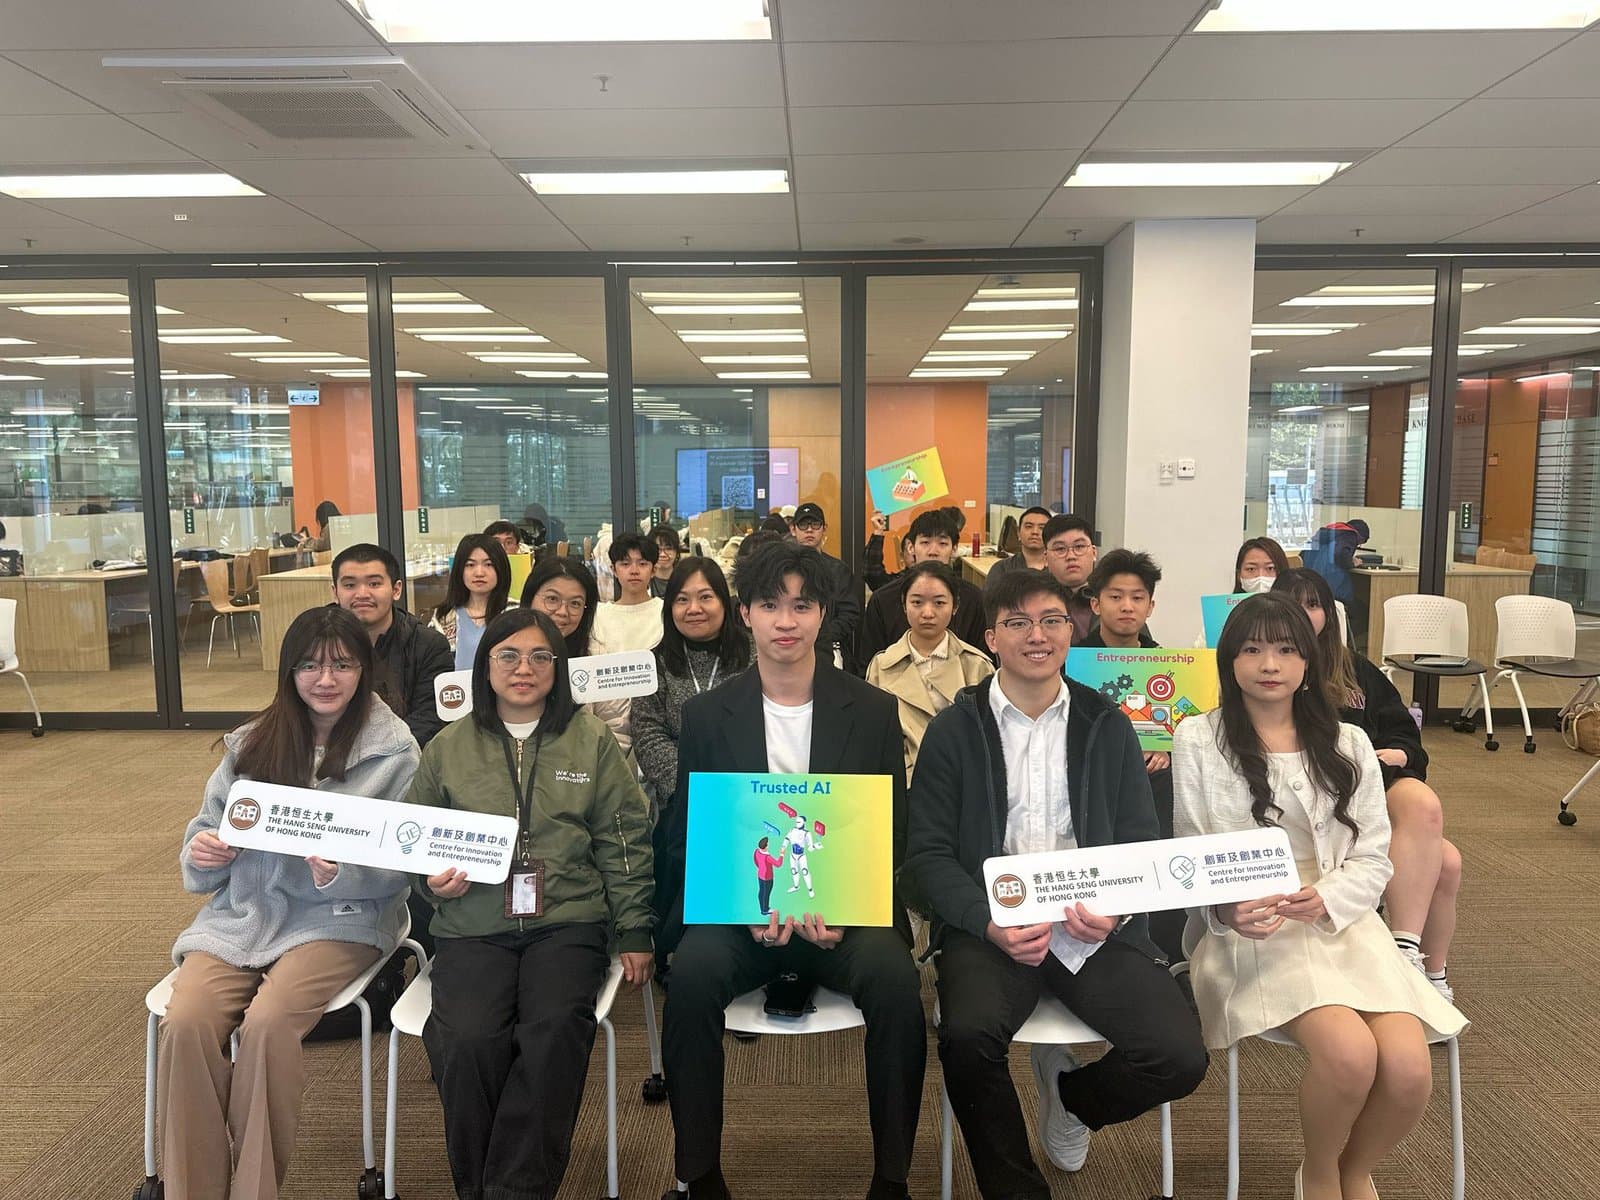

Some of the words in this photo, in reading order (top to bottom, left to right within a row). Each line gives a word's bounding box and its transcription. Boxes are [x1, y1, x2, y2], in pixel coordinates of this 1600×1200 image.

[1097, 652, 1195, 664] Entrepreneurship
[750, 780, 808, 794] Trusted
[813, 781, 831, 794] AI
[268, 816, 282, 825] THE
[283, 819, 305, 828] HANG
[307, 823, 326, 831] SENG
[328, 825, 370, 838] UNIVERSITY
[277, 828, 299, 836] HONG
[300, 831, 322, 840] KONG
[432, 827, 508, 847] 創新及創業中心
[429, 842, 453, 850] Centre
[454, 845, 465, 853] for
[466, 848, 503, 858] Innovation
[1204, 847, 1286, 865] 創新及創業中心
[442, 852, 502, 867] Entrepreneurship
[1208, 868, 1233, 877] Centre
[1234, 866, 1245, 874] for
[1246, 863, 1286, 872] Innovation
[1225, 870, 1289, 884] Entrepreneurship
[1034, 885, 1050, 894] THE
[1051, 883, 1075, 892] HANG
[1077, 880, 1098, 889] SENG
[1099, 876, 1144, 887] UNIVERSITY
[1049, 893, 1073, 902] HONG
[1074, 890, 1097, 899] KONG
